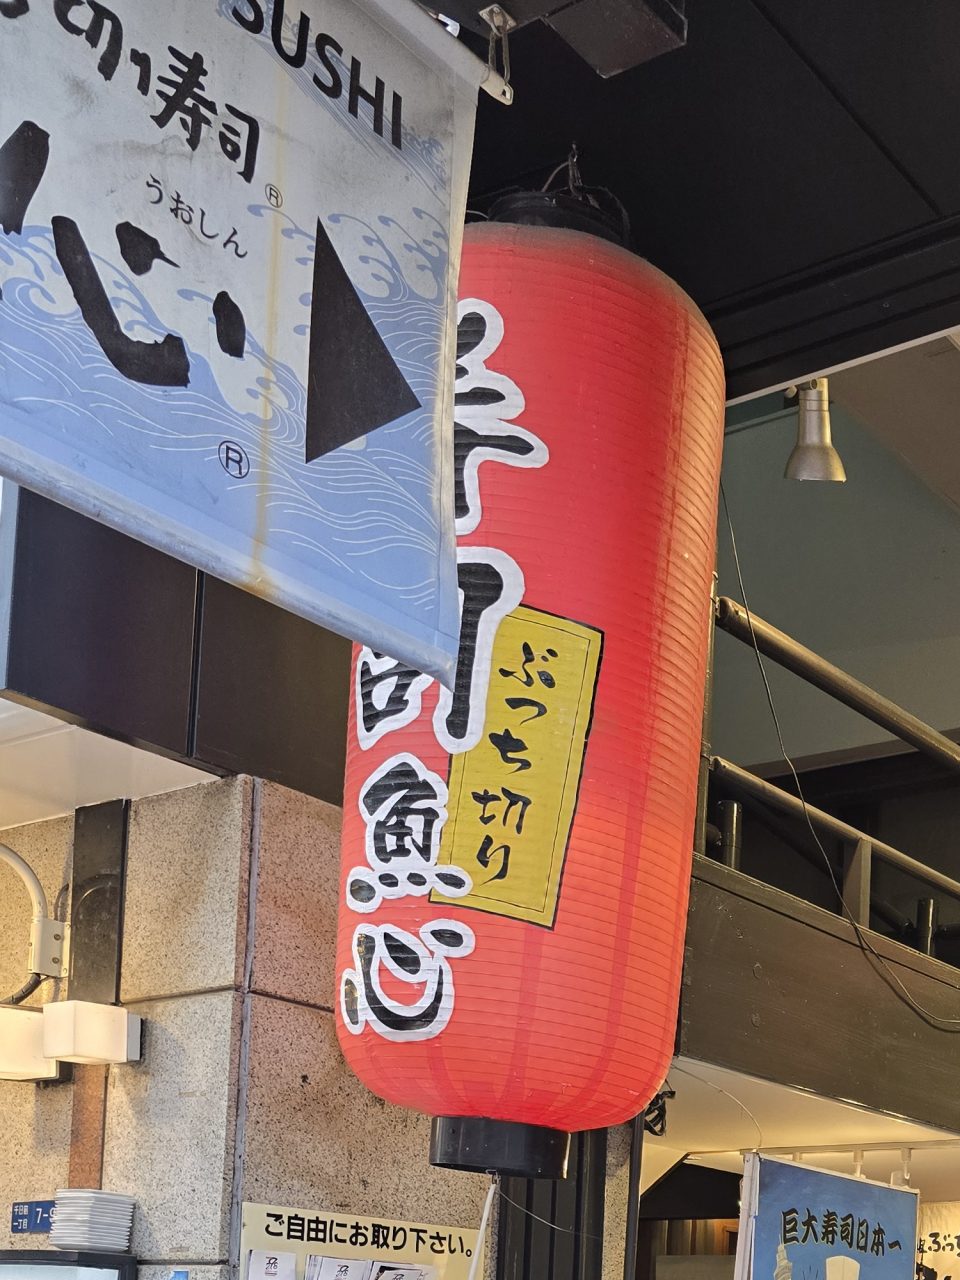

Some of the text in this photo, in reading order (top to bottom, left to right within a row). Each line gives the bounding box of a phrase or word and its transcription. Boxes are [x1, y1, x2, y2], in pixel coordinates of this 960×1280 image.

[0, 0, 260, 183] 切り寿司
[232, 0, 402, 151] SUSHI
[145, 173, 248, 260] うおしん
[265, 1212, 473, 1258] ご自由にお取り下さい。
[781, 1208, 902, 1257] 巨大寿司日本一
